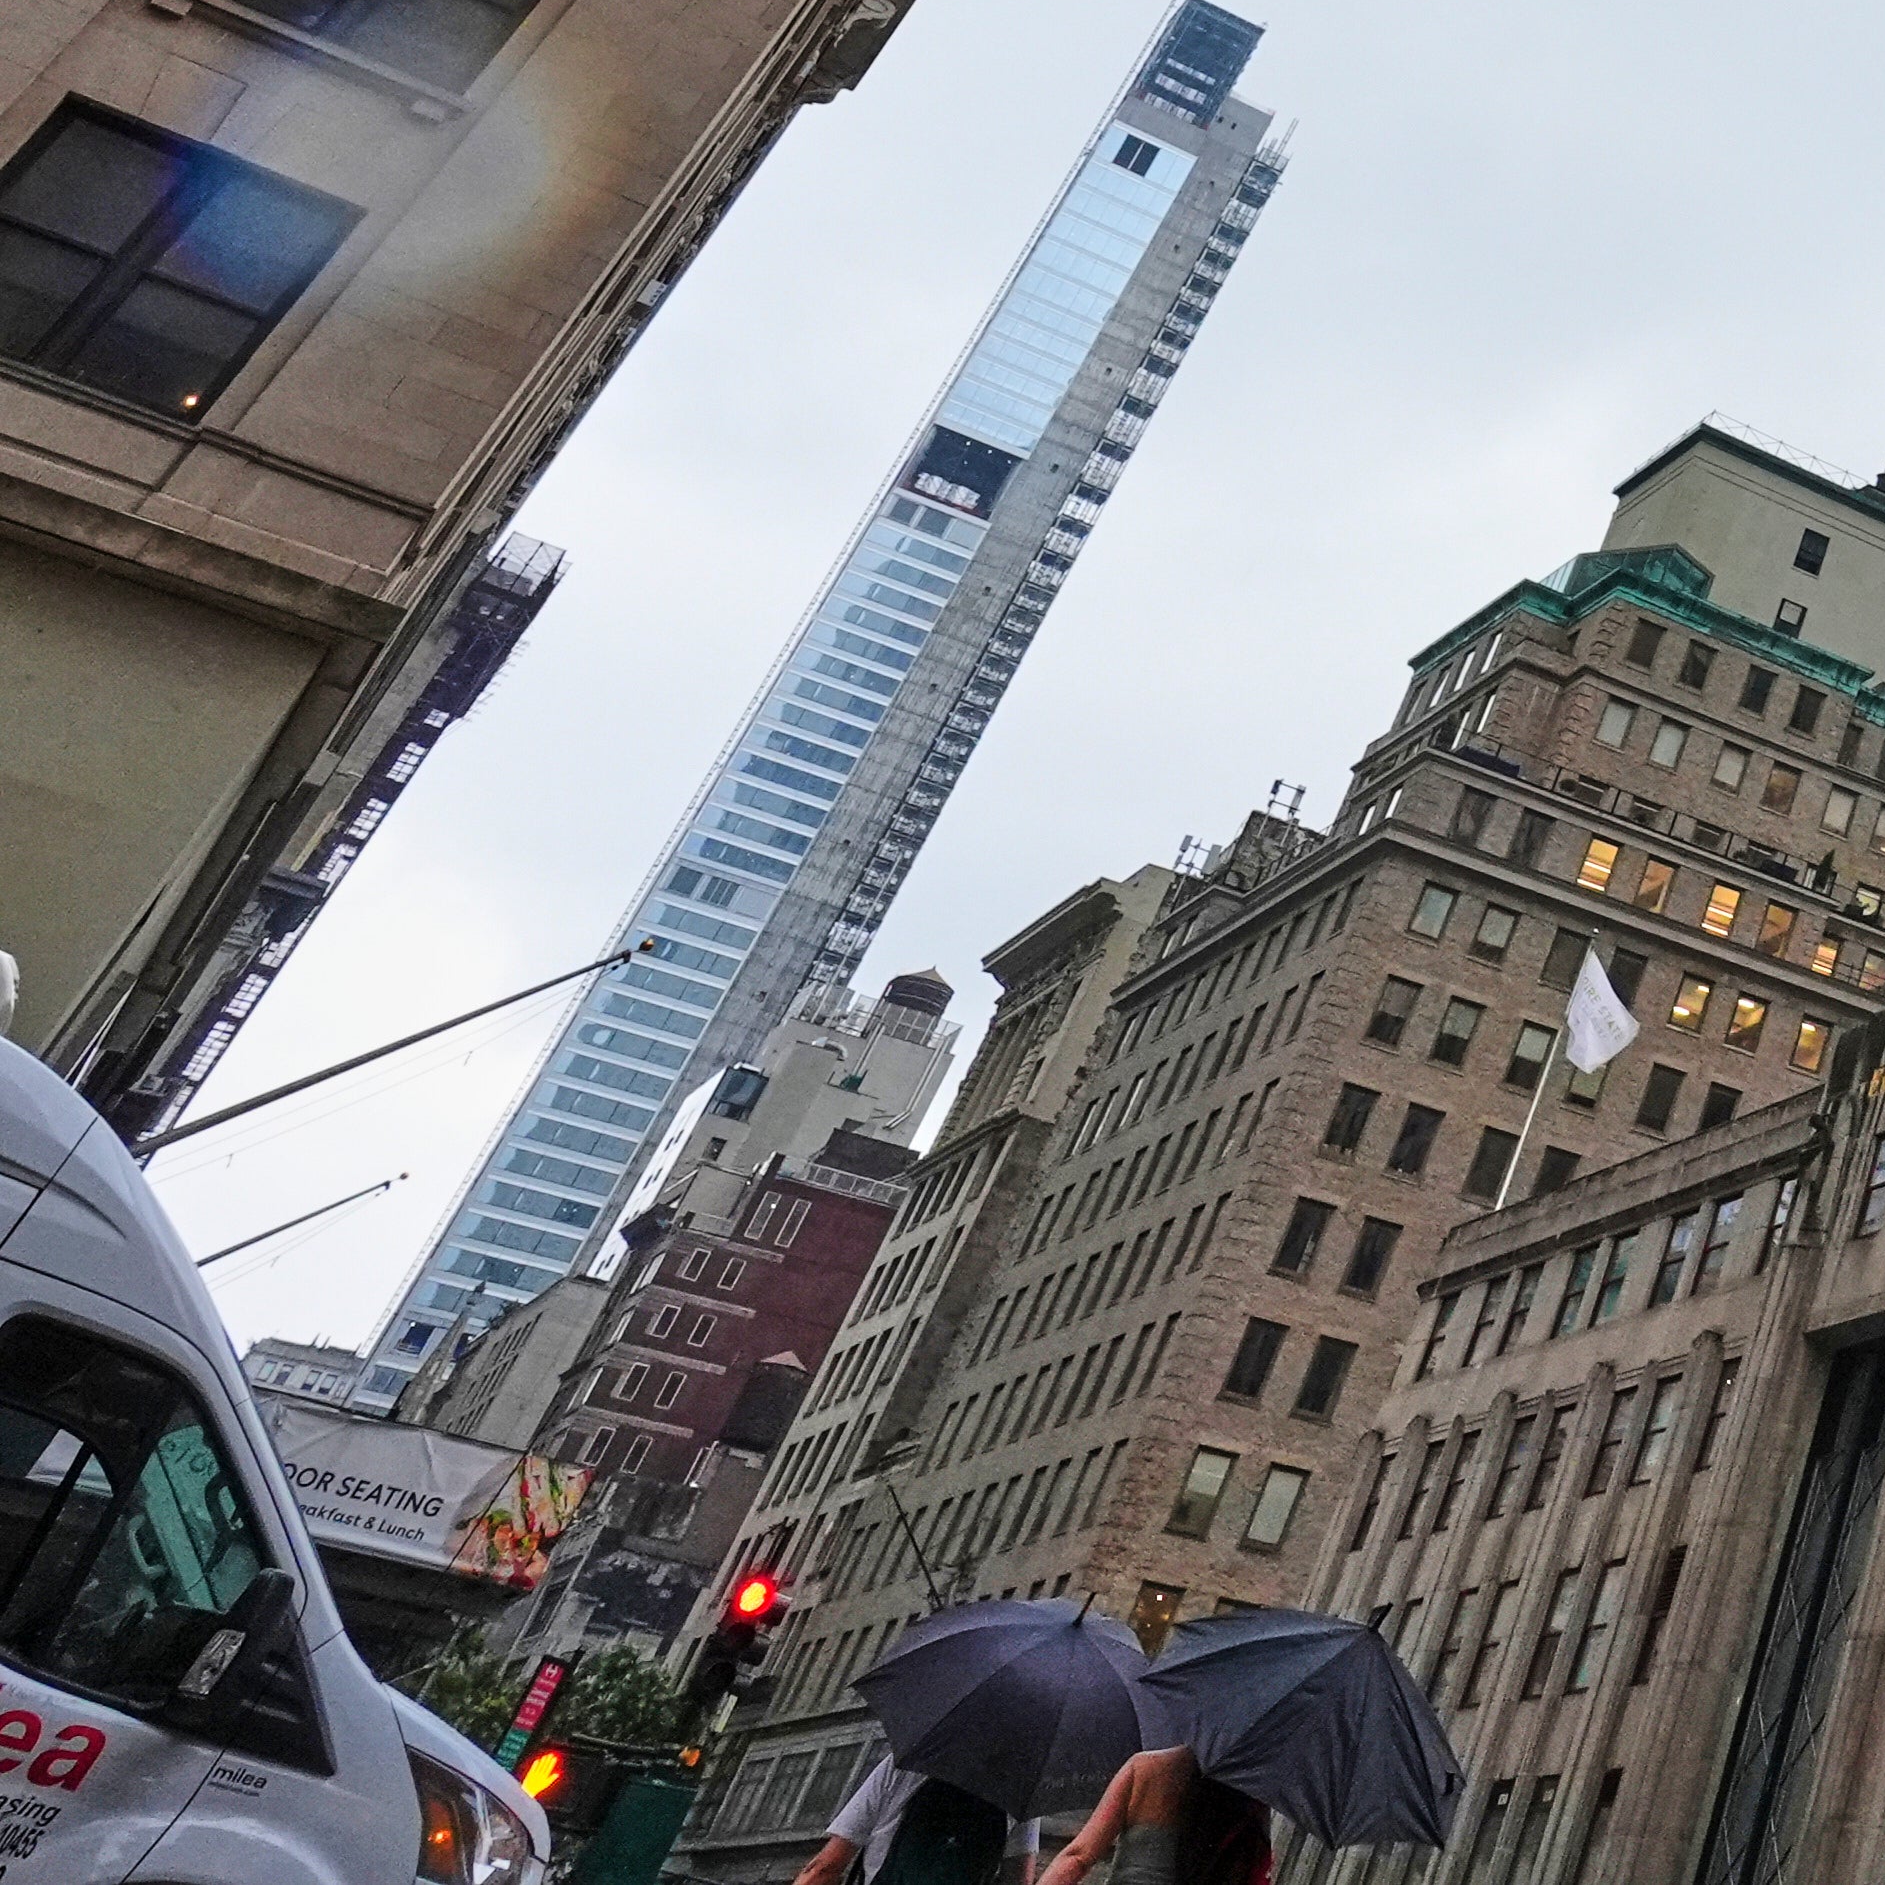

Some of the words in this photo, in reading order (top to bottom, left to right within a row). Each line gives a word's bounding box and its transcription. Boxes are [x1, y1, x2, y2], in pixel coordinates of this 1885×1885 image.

[336, 1477, 444, 1516] SEATING
[363, 1517, 374, 1529] &
[377, 1520, 425, 1541] Lunch
[212, 1767, 268, 1789] milea
